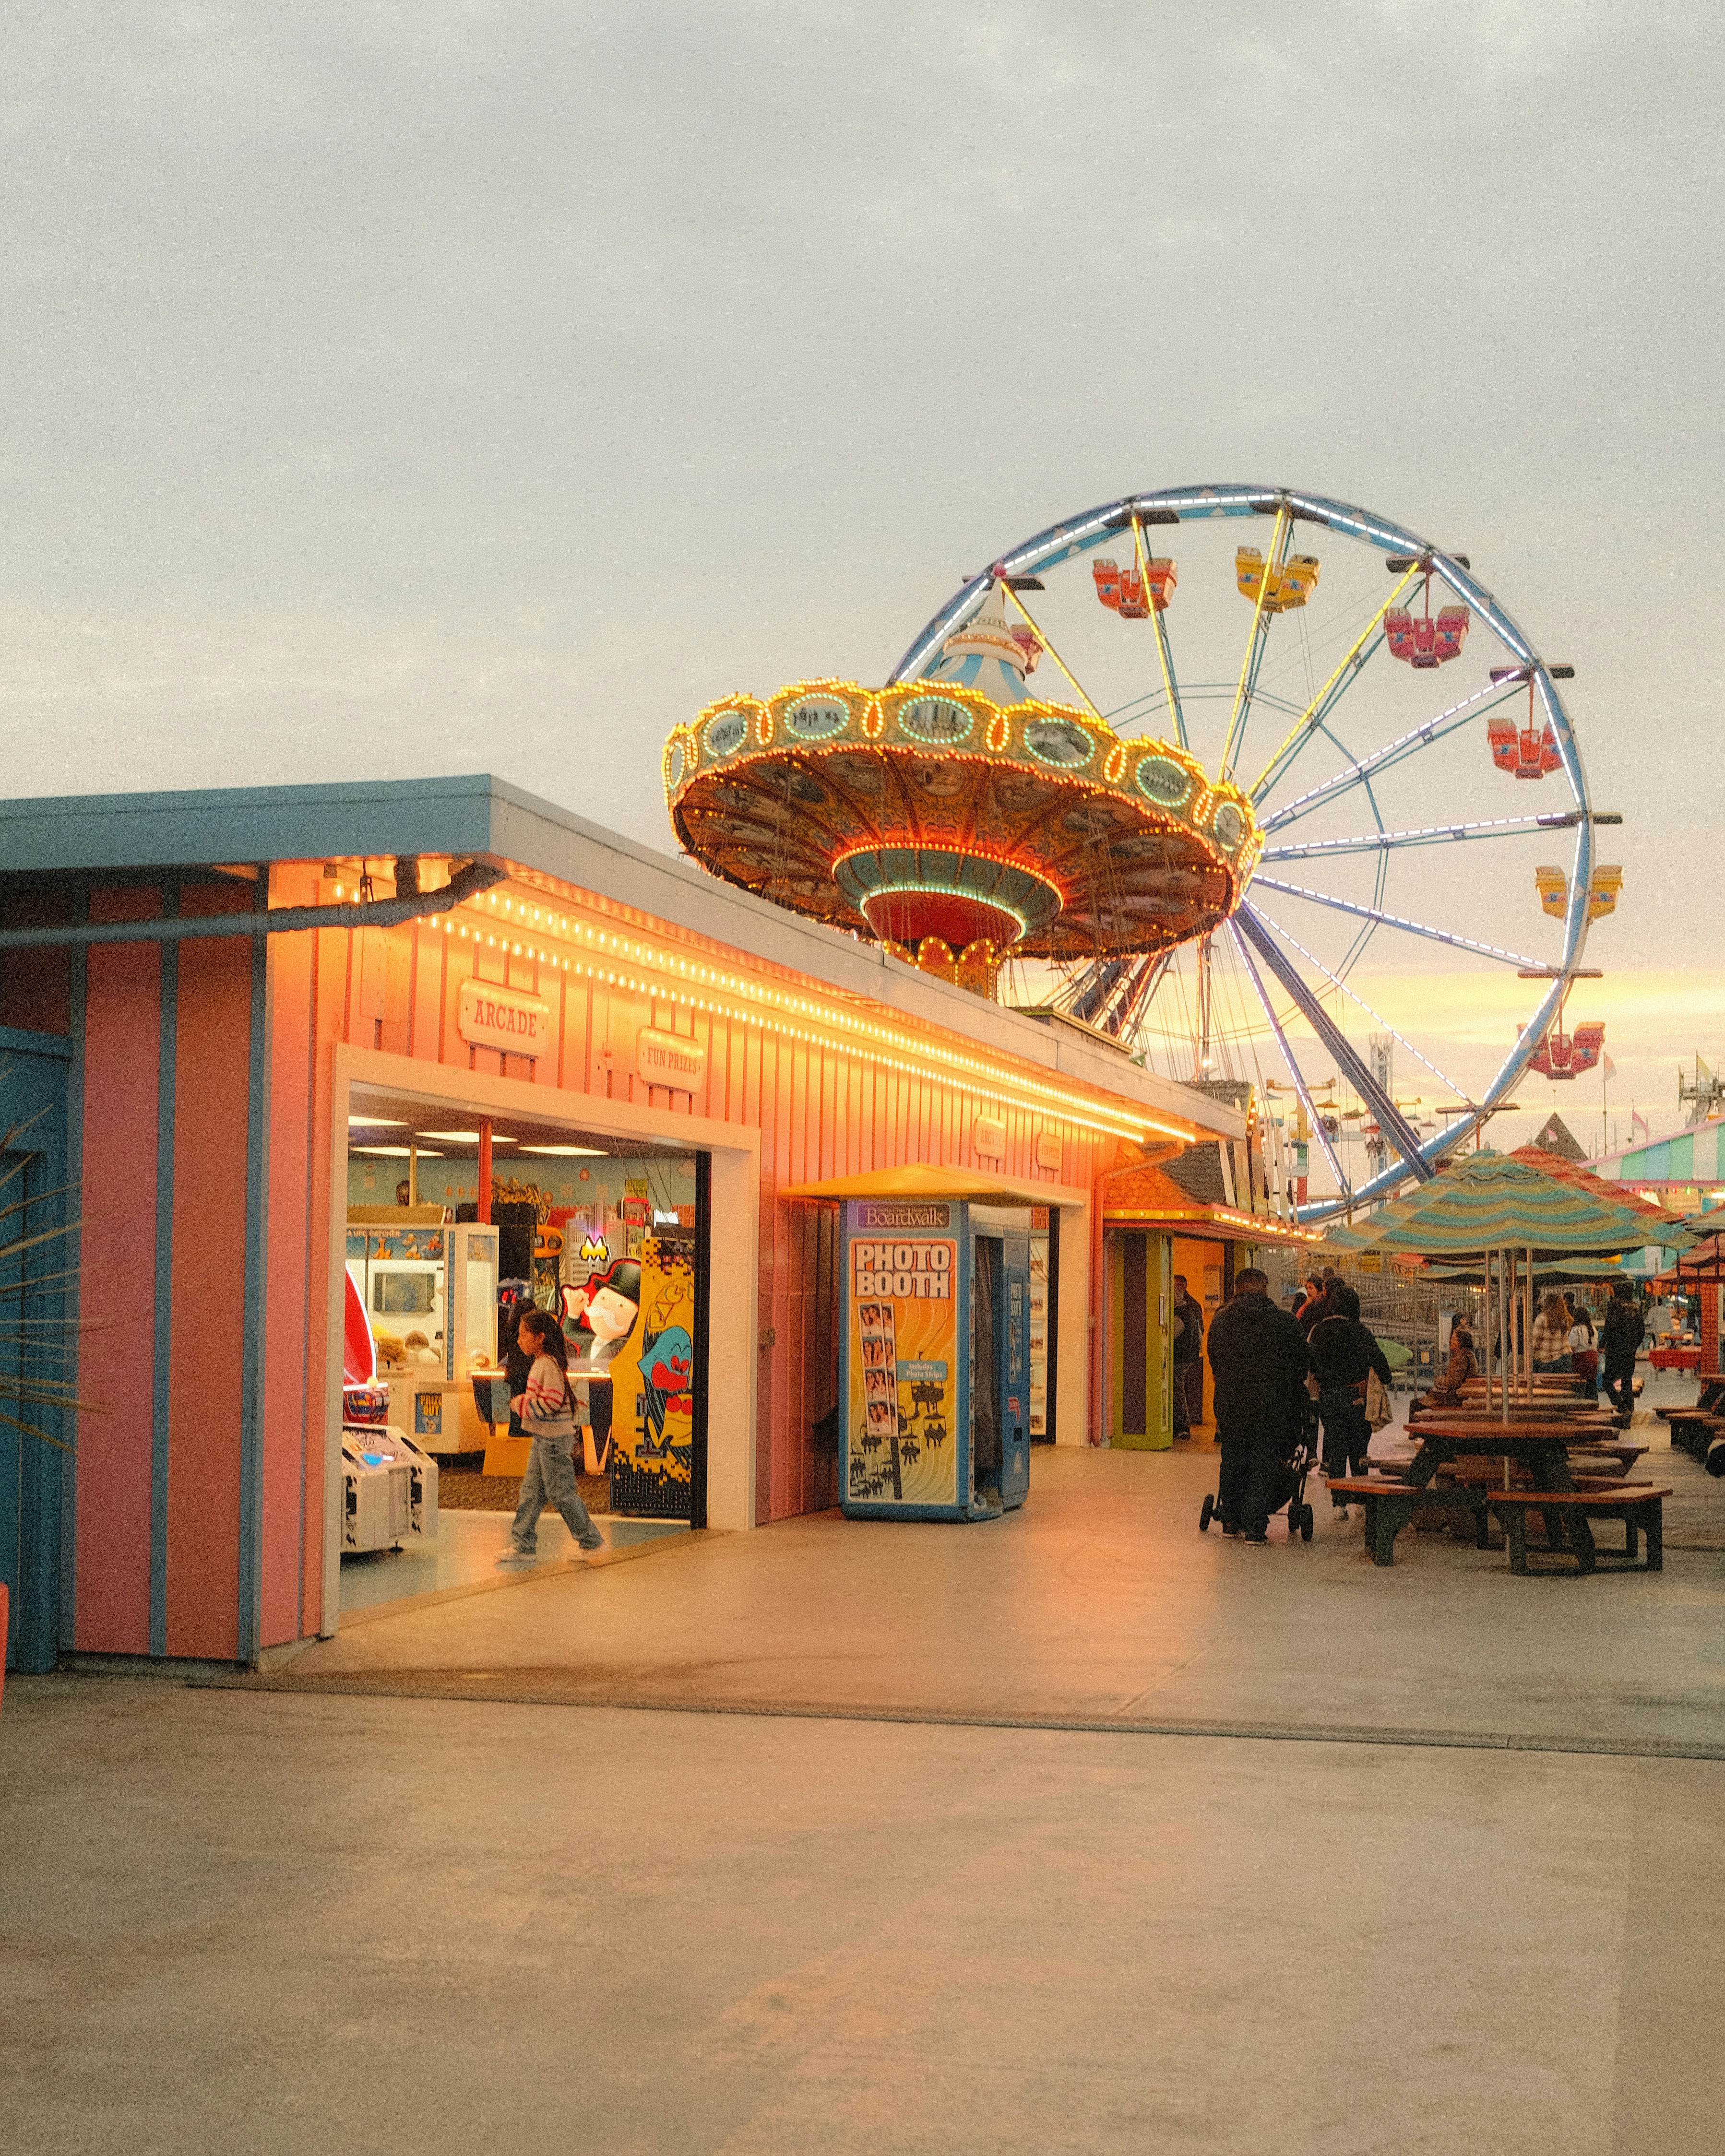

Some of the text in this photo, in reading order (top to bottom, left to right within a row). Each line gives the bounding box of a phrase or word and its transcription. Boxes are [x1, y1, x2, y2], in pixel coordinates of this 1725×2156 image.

[475, 999, 536, 1037] ARCADE
[648, 1046, 697, 1075] FUN PRIZES
[867, 1207, 943, 1226] Boardwalk
[855, 1244, 951, 1271] PHOTO
[855, 1271, 950, 1298] BOOTH
[925, 1370, 943, 1379] Strips
[423, 1405, 439, 1416] OUT
